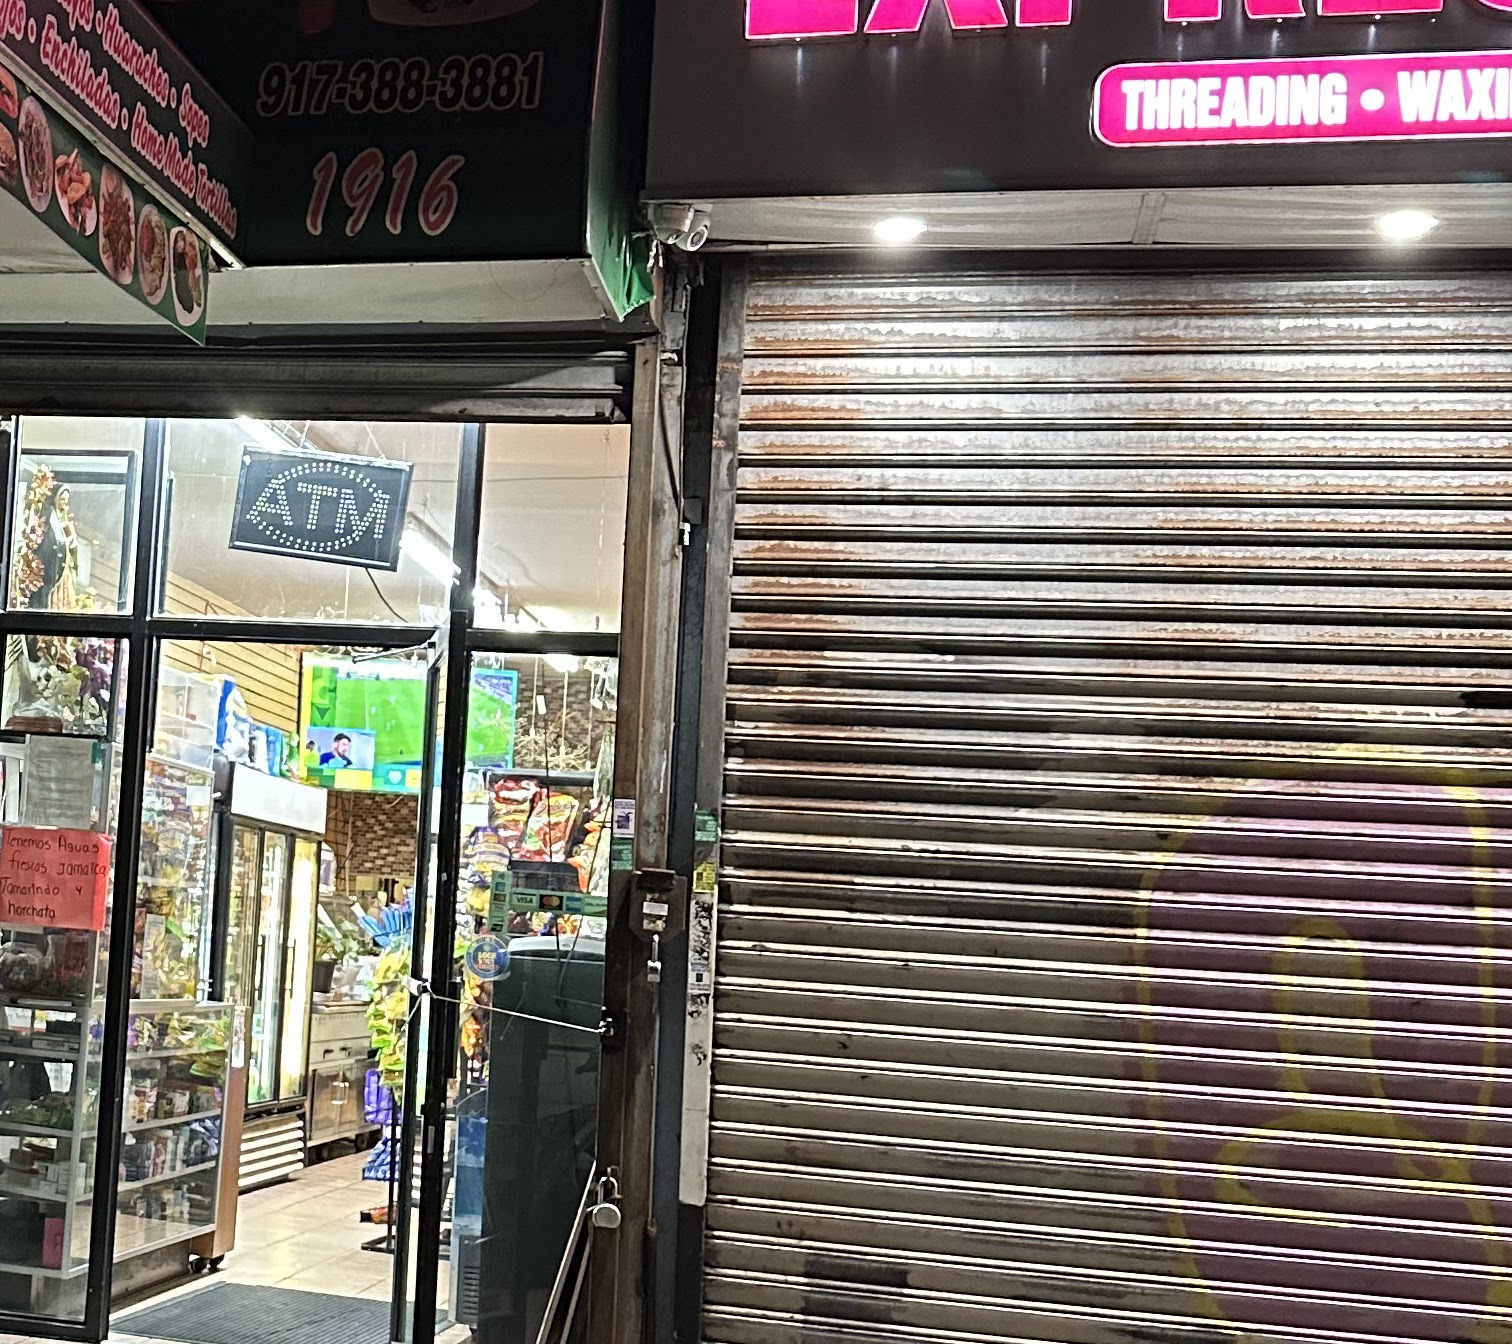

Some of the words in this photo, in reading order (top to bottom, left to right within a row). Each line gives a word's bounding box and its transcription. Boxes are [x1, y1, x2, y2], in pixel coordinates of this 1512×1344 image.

[102, 3, 169, 108] Huaraches
[179, 83, 209, 148] Sopes
[255, 51, 546, 119] 917-388-3881
[1121, 72, 1348, 131] THREADING
[1397, 67, 1512, 123] WAXI
[41, 14, 120, 130] Enchiladas
[131, 101, 165, 170] Home
[163, 132, 197, 199] Made
[196, 162, 237, 239] Tortillas
[304, 146, 468, 239] 1916
[245, 476, 392, 542] ATM
[5, 829, 51, 851] Tenemos
[57, 834, 100, 853] Aguas
[0, 876, 60, 897] Tamarindo
[7, 900, 56, 922] horchata
[516, 896, 534, 904] VISA
